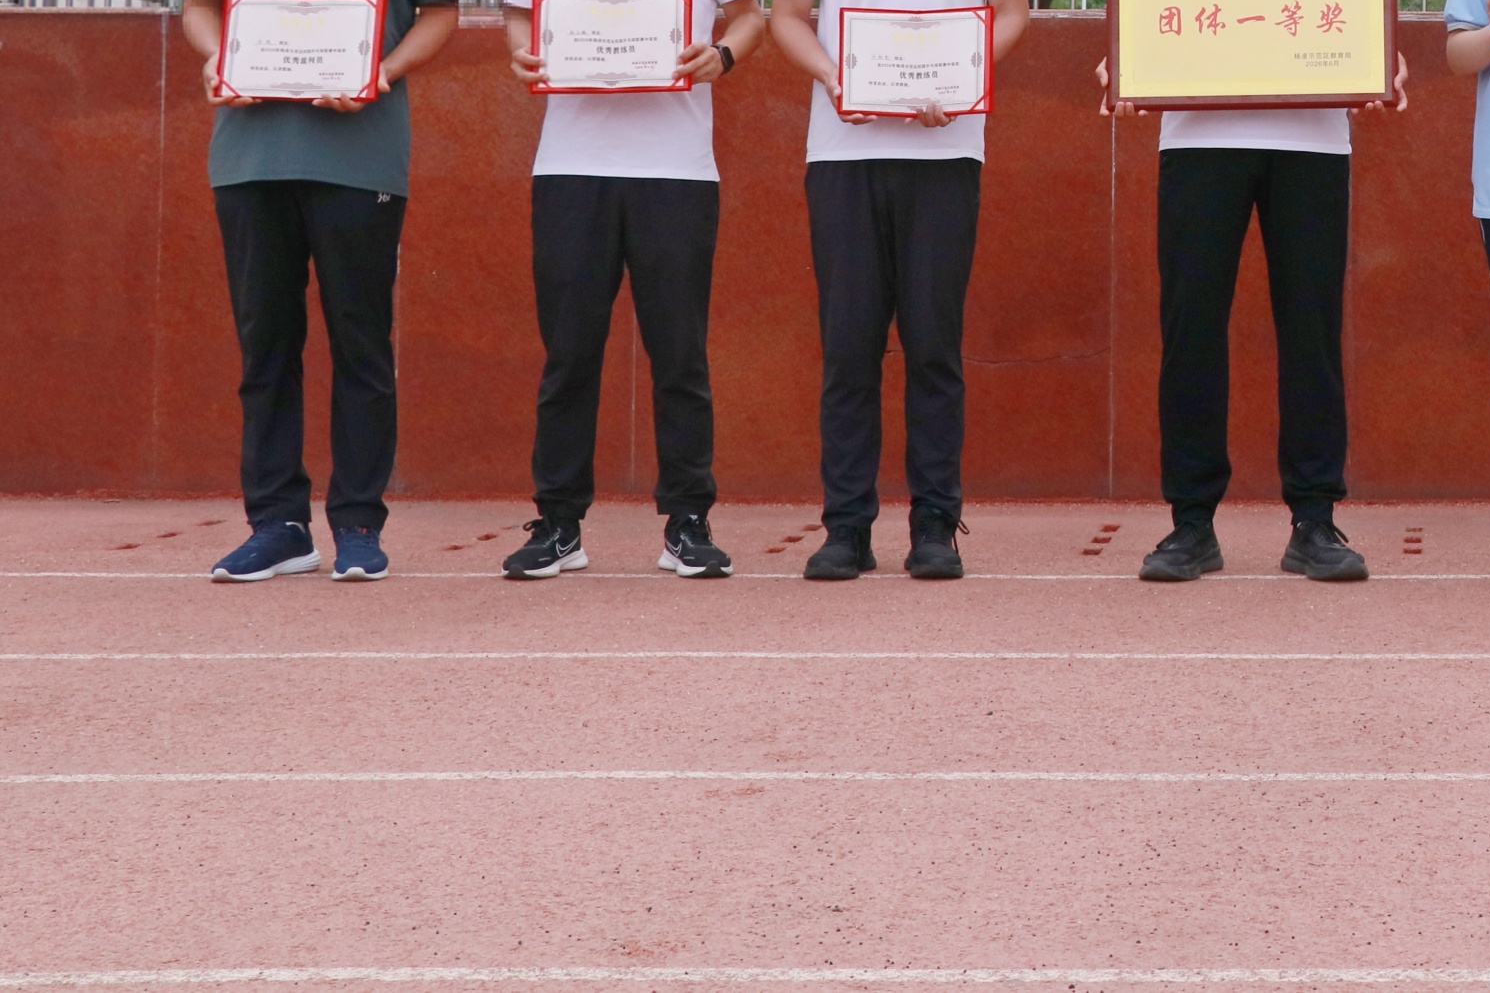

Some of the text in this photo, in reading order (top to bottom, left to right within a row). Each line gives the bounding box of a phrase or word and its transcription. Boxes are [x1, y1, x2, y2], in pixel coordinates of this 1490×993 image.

[1158, 0, 1347, 37] 团体一等奖
[596, 45, 636, 55] 优秀教练员
[1293, 51, 1352, 60] 杨凌示范区教育局
[899, 70, 938, 80] 优秀教练员
